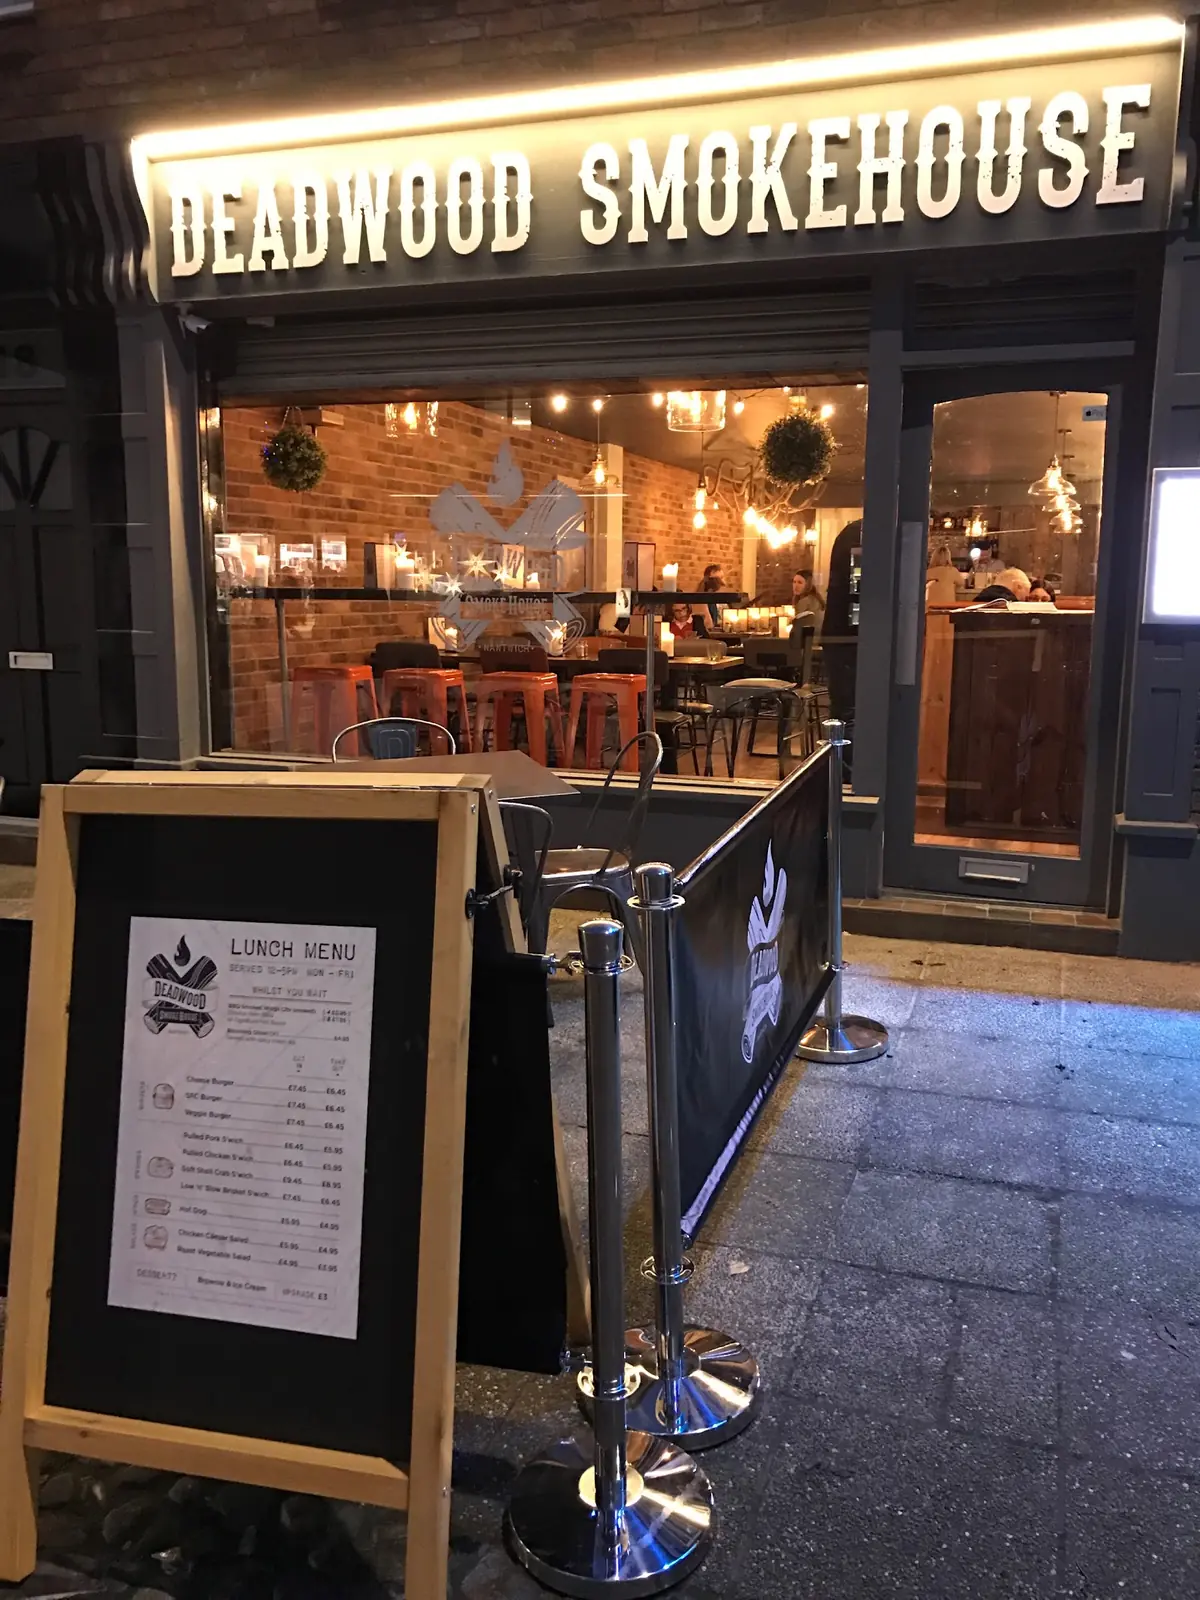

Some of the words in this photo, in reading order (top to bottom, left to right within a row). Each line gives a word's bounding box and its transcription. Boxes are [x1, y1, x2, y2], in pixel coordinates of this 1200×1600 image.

[168, 150, 536, 278] DEADWOOD
[577, 83, 1154, 247] SMOKEHOUSE
[230, 938, 293, 957] LUNCH
[304, 941, 356, 961] MENU
[228, 962, 263, 974] SERVED
[337, 969, 354, 979] FRI
[154, 980, 207, 1010] DEADWOOD
[287, 986, 304, 997] YOU
[211, 1077, 234, 1087] Burger
[287, 1083, 307, 1092] £7.45
[325, 1087, 347, 1096] £6.45
[200, 1093, 223, 1102] Burger
[286, 1100, 306, 1109] £7.45
[324, 1104, 346, 1113] £6.45
[208, 1110, 231, 1120] Burger
[285, 1117, 305, 1126] £7.45
[323, 1121, 345, 1130] £6.45
[182, 1130, 204, 1141] Pulled
[204, 1133, 220, 1142] Pork
[181, 1147, 203, 1157] Pulled
[203, 1150, 230, 1160] Chicken
[180, 1181, 194, 1190] Low
[204, 1184, 221, 1193] Slow
[178, 1205, 191, 1213] Hot
[192, 1206, 208, 1216] Dog
[177, 1228, 204, 1238] Chicken
[228, 1234, 249, 1244] Salad
[231, 1252, 251, 1262] Salad
[243, 1281, 267, 1292] Cream
[317, 1291, 328, 1301] £3
